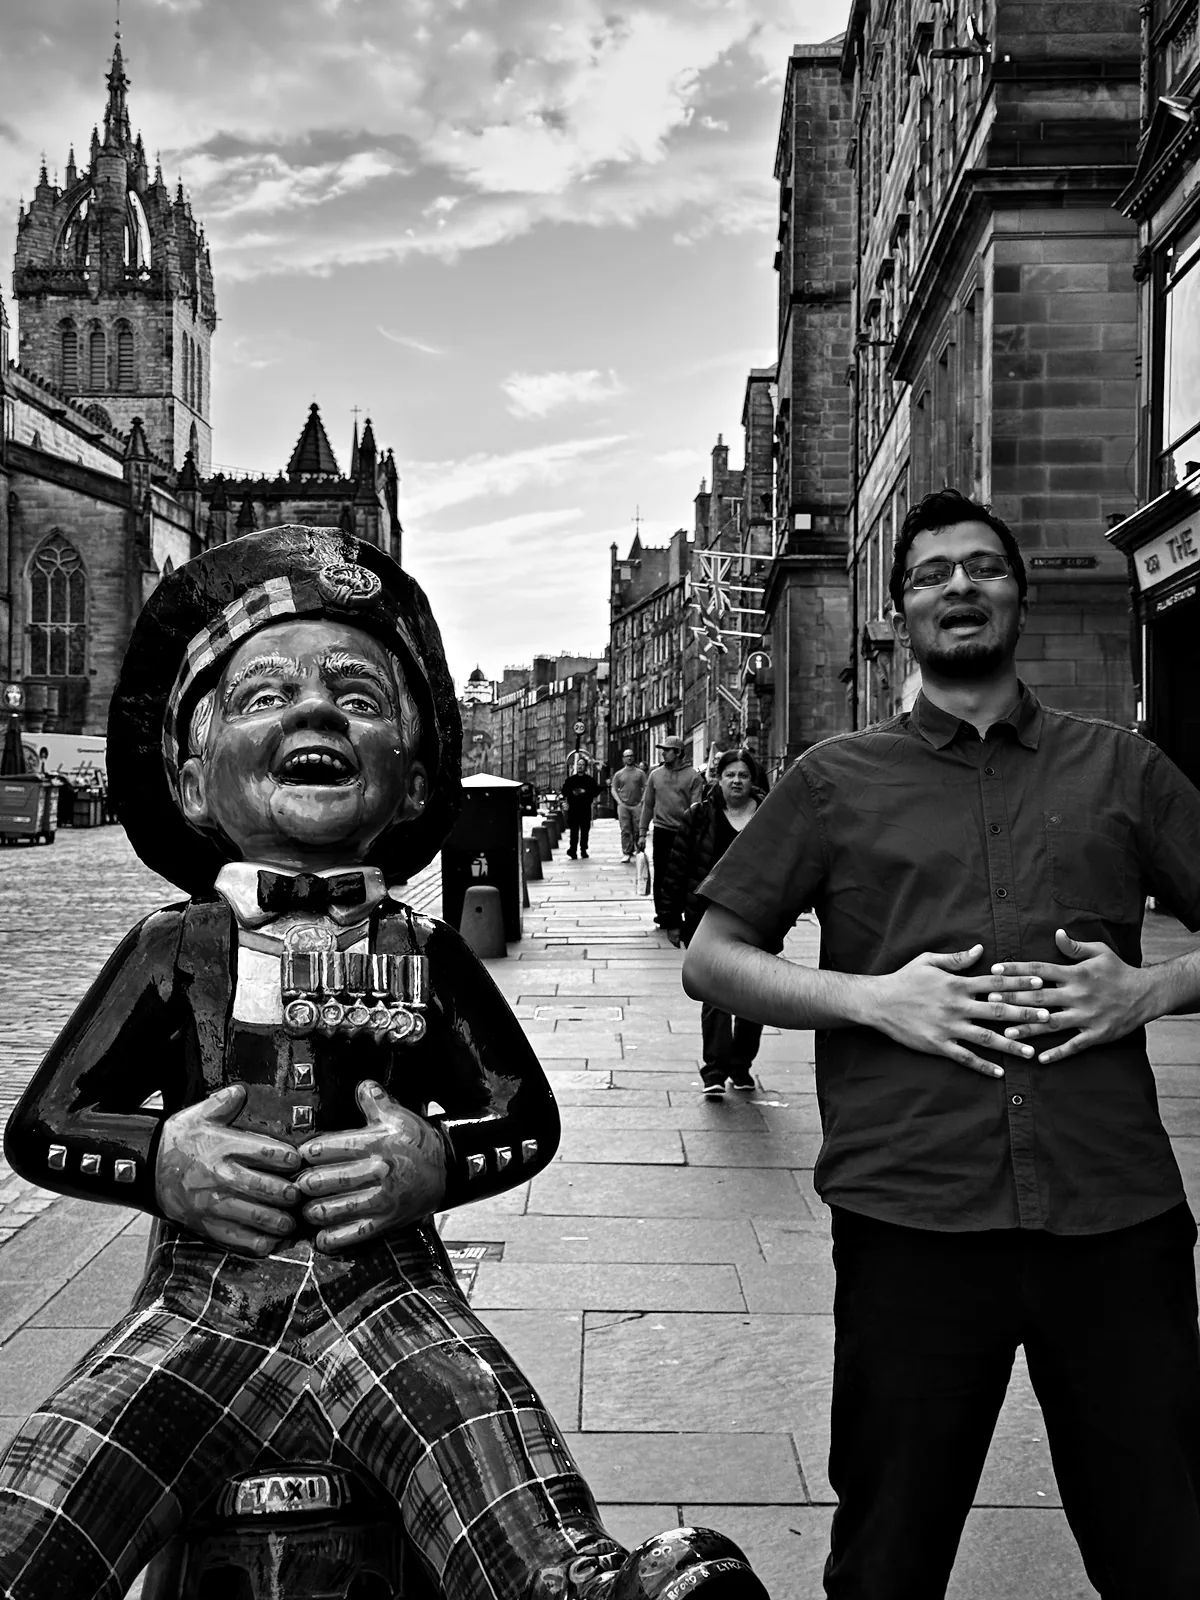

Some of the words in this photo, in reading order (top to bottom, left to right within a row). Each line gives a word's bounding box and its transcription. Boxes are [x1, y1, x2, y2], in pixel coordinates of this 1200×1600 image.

[1165, 527, 1198, 564] THE
[1156, 595, 1174, 613] FILLING
[1173, 585, 1197, 604] STATION
[249, 1476, 320, 1507] TAXI
